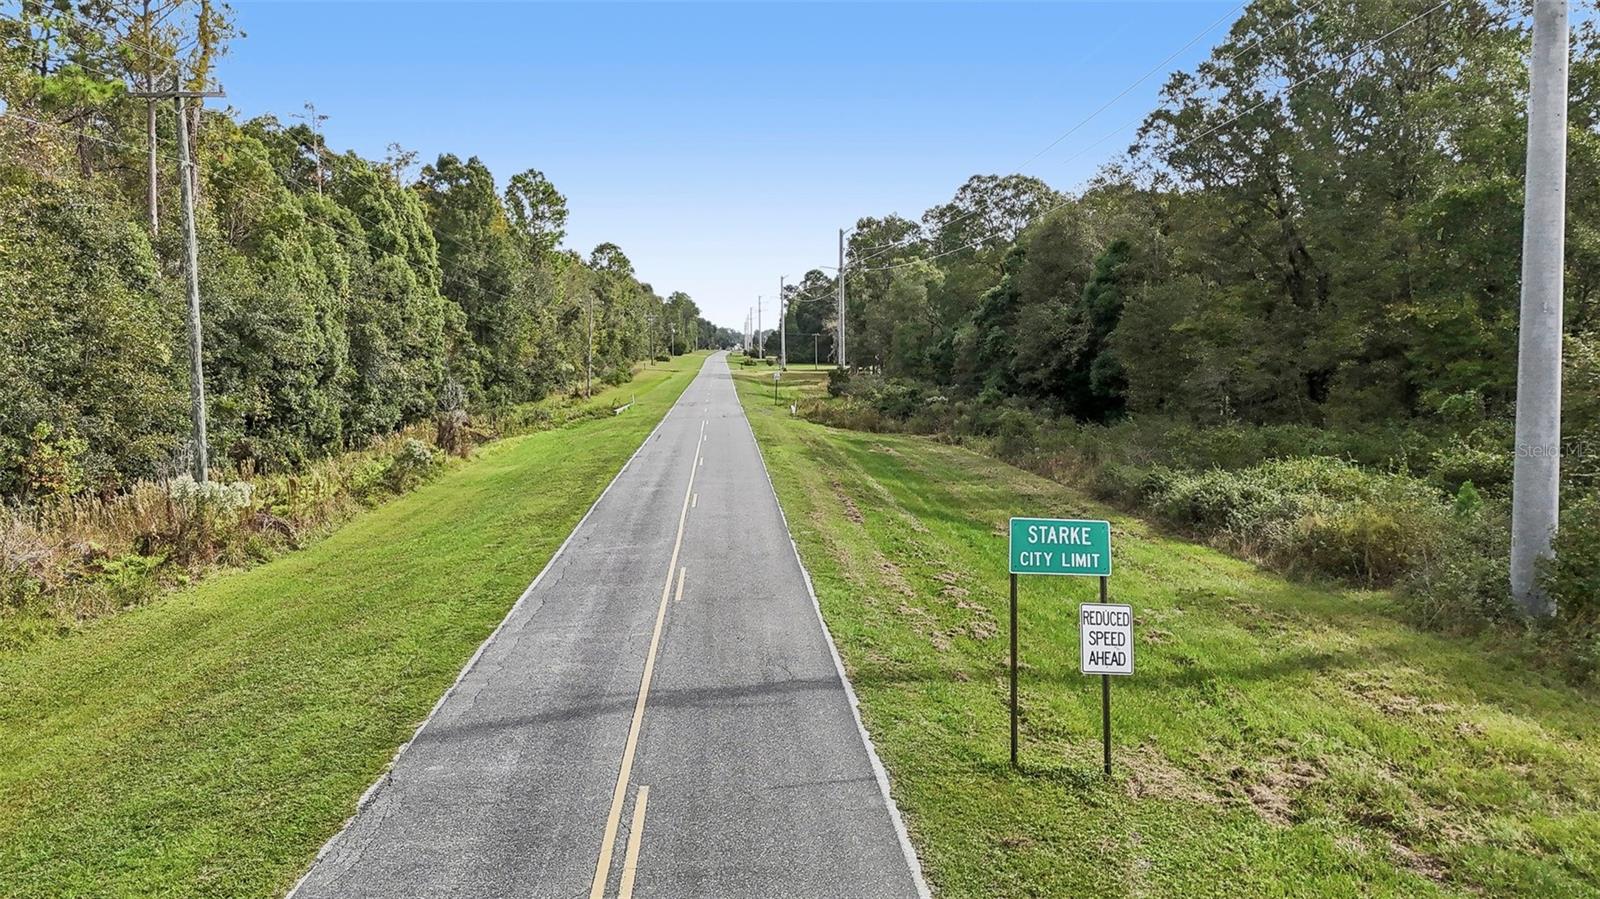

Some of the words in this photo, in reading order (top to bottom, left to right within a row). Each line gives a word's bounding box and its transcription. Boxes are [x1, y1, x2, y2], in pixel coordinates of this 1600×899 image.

[1028, 525, 1092, 545] STARKE
[1020, 551, 1053, 566] CITY
[1061, 553, 1100, 568] LIMIT
[1082, 610, 1130, 627] REDUCED
[1088, 630, 1126, 647] SPEED
[1088, 651, 1126, 666] AHEAD
